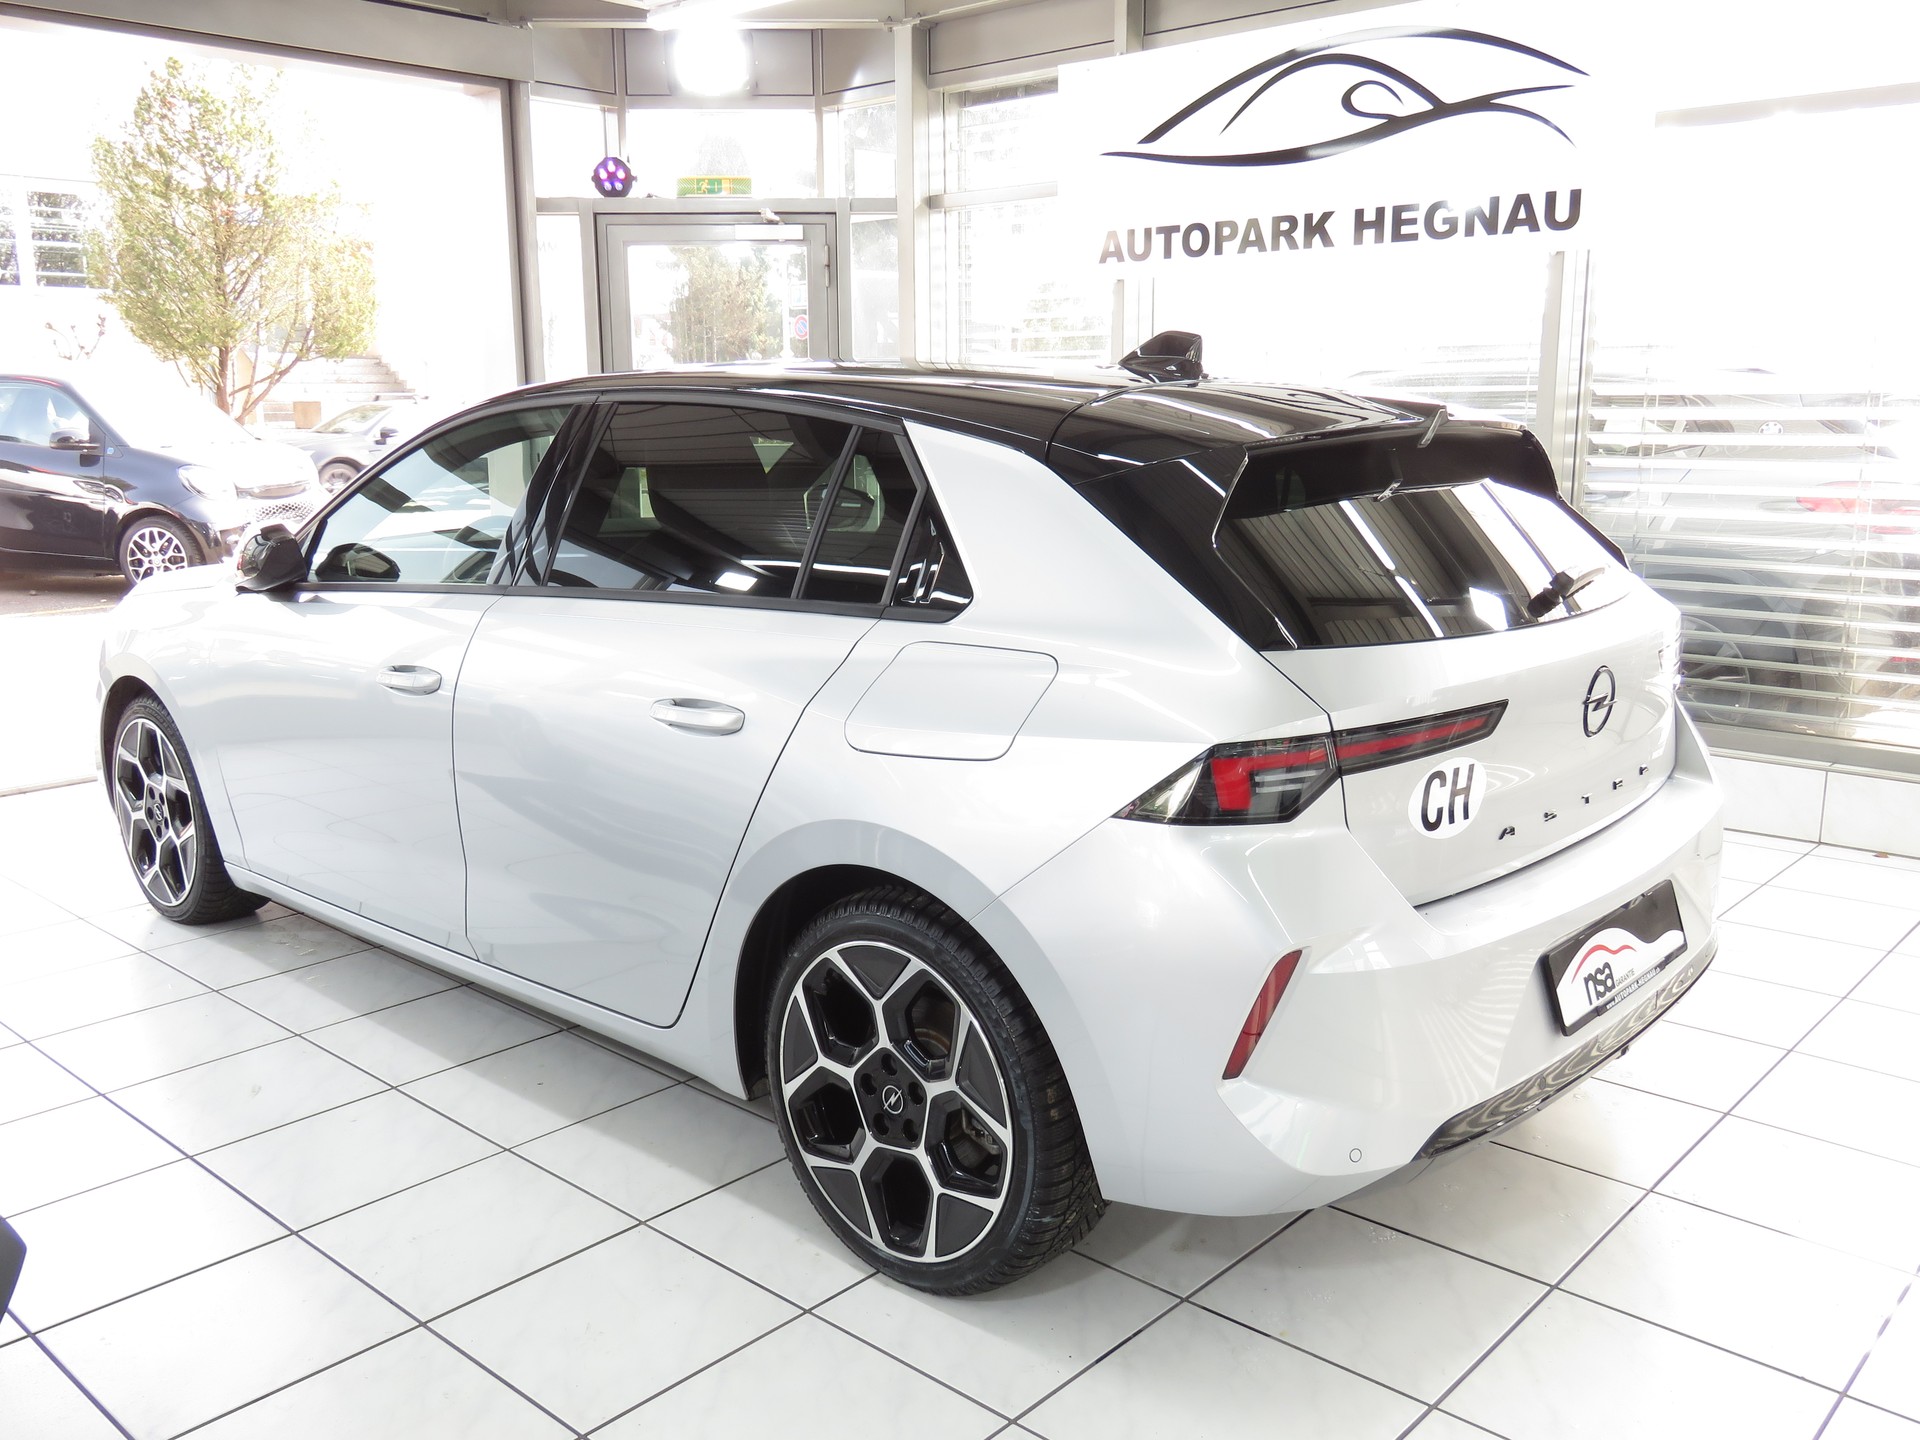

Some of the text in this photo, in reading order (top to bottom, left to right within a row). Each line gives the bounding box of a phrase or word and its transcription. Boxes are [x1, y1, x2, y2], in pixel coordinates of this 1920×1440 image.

[1099, 188, 1582, 263] AUTOPARK HEGNAU
[1420, 763, 1475, 832] CH
[1583, 962, 1616, 1006] nsa
